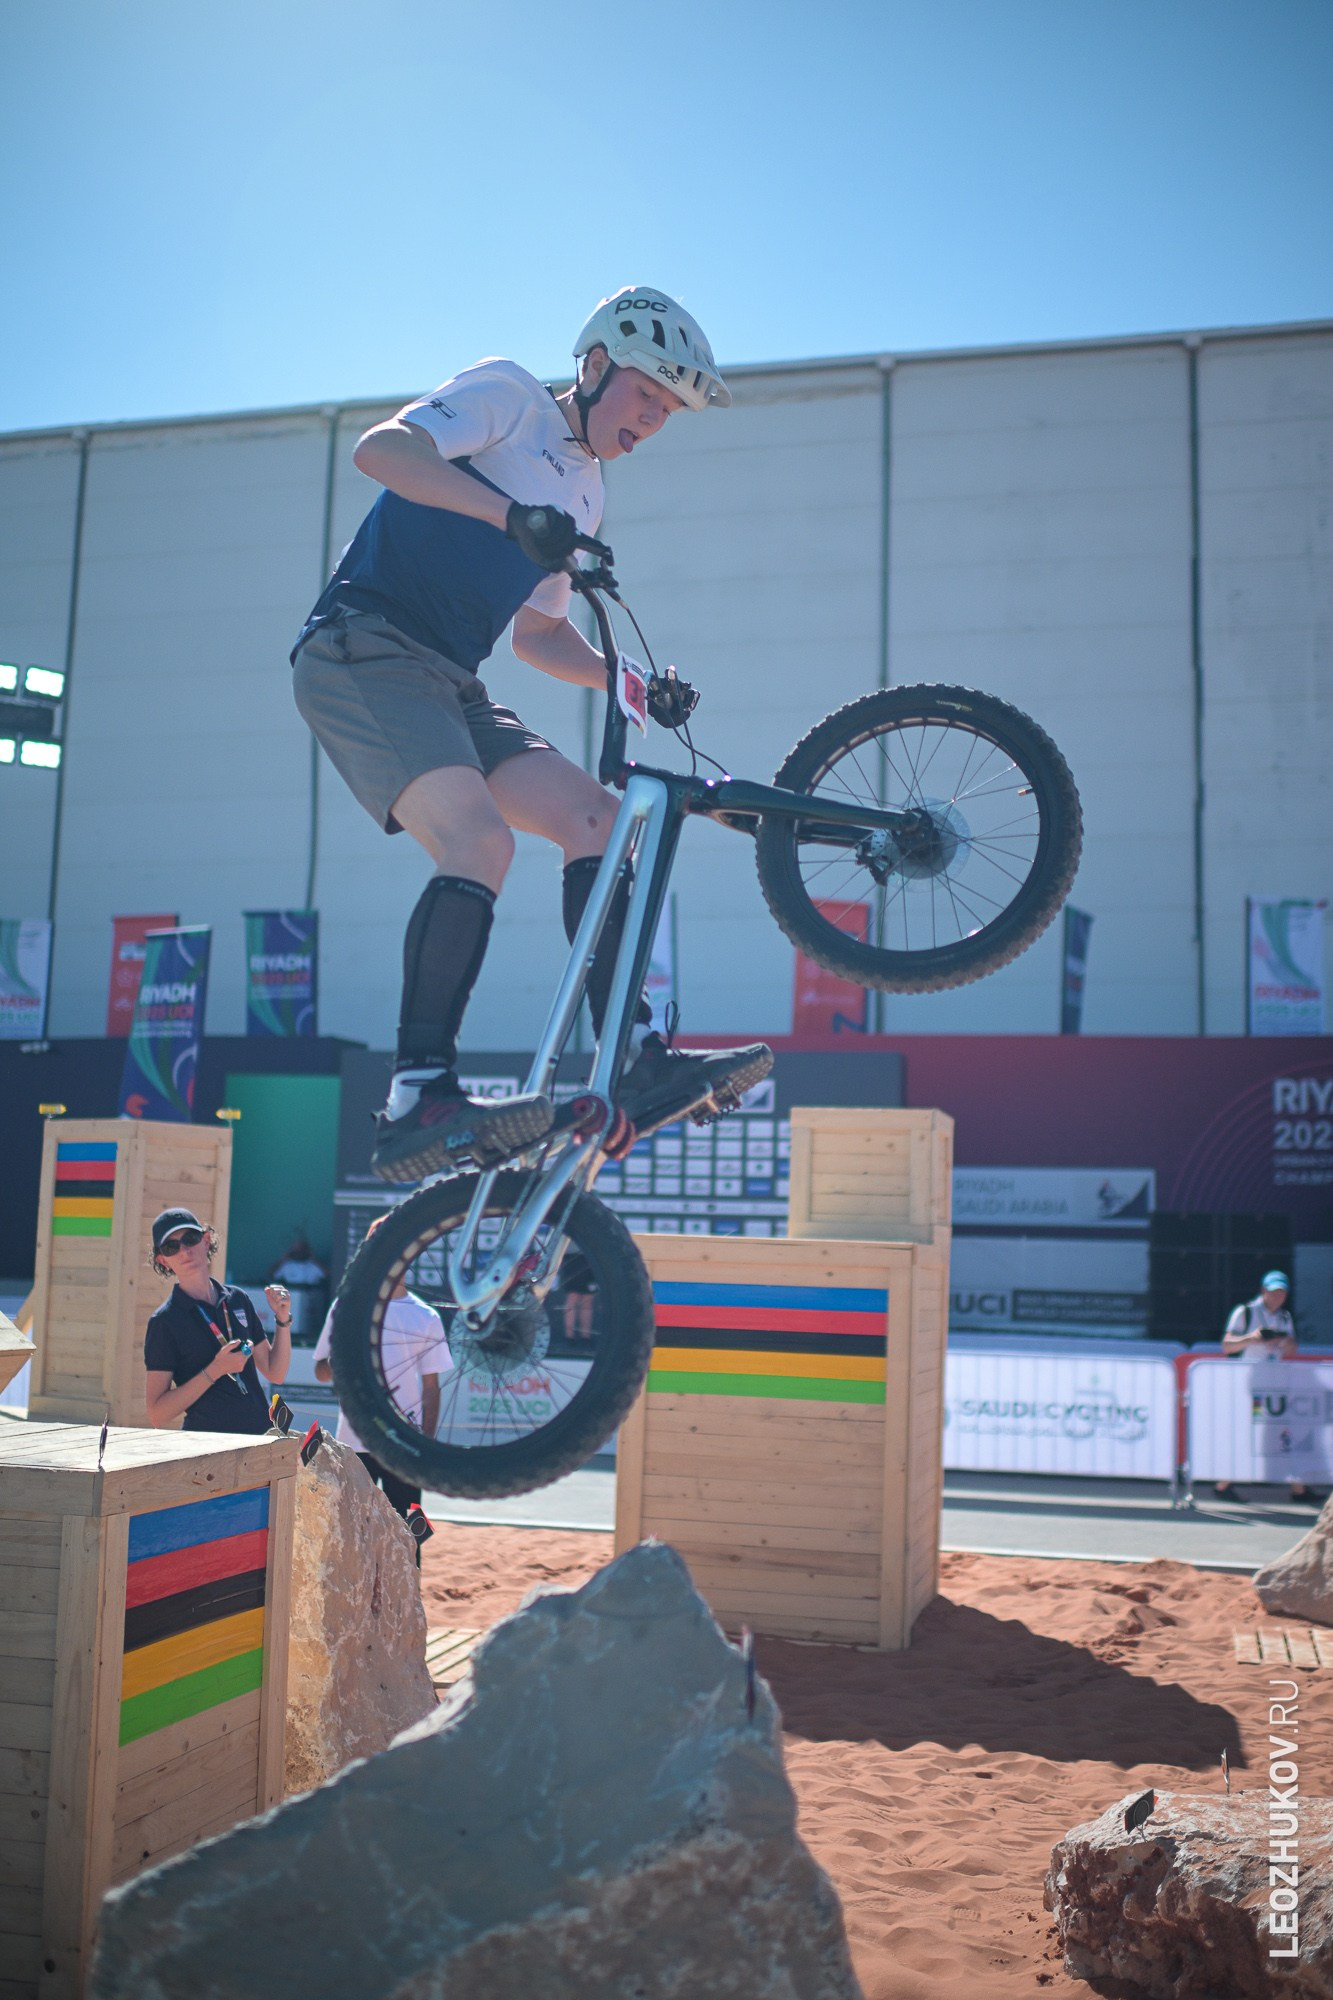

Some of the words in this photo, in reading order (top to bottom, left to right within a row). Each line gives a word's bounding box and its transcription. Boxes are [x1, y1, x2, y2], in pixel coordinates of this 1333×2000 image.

[541, 448, 566, 478] FINLAND
[140, 981, 197, 1004] RIYADH
[1272, 1077, 1333, 1114] RIY
[1273, 1119, 1333, 1150] 202
[954, 1178, 1016, 1193] RIYADH
[955, 1197, 1006, 1214] SAUDI
[1010, 1198, 1070, 1215] ARABIA
[954, 1292, 1006, 1315] UCI
[960, 1399, 1037, 1419] SAUDI
[1044, 1402, 1150, 1424] CYCLING
[1265, 1394, 1320, 1417] UCI
